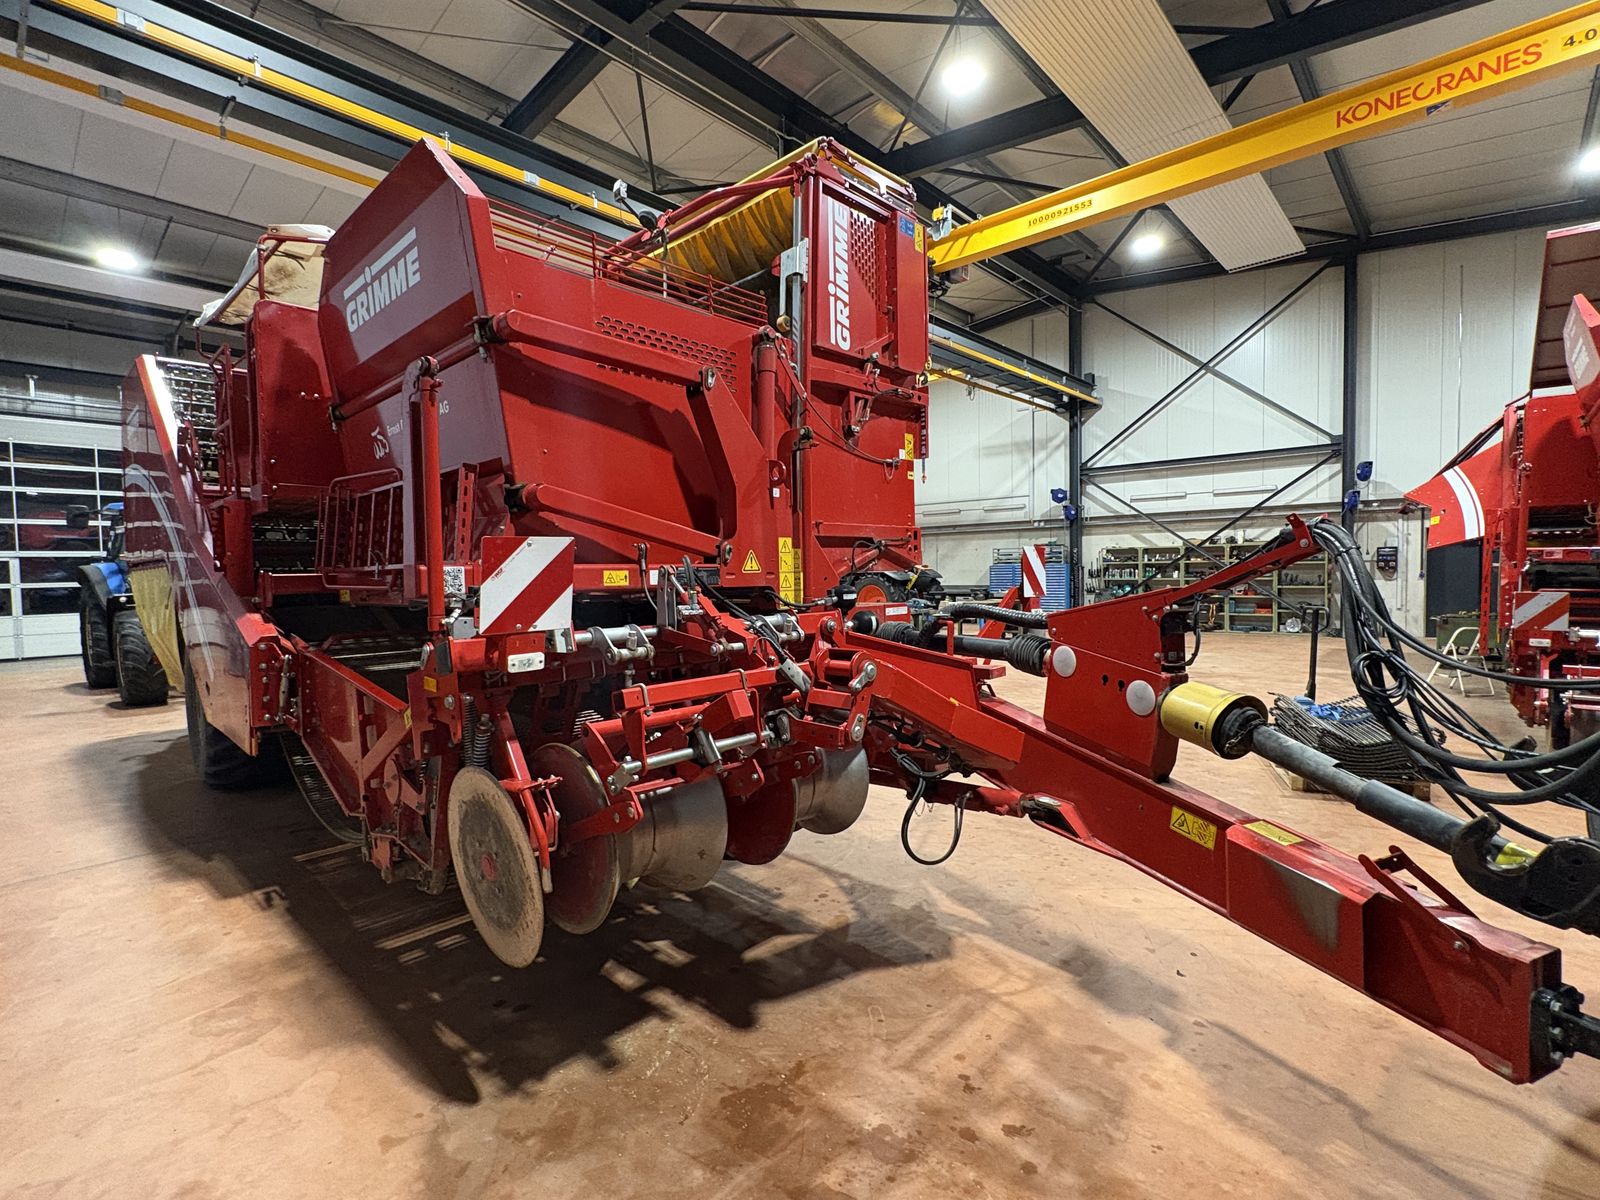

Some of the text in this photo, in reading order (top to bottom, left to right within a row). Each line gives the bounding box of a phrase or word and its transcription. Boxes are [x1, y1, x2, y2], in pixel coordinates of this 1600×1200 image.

[1563, 28, 1598, 47] 4.0
[1337, 42, 1543, 128] KONECRANES
[1028, 199, 1093, 227] 10000921553
[345, 246, 421, 333] GRIMME
[829, 199, 851, 350] GRIMME
